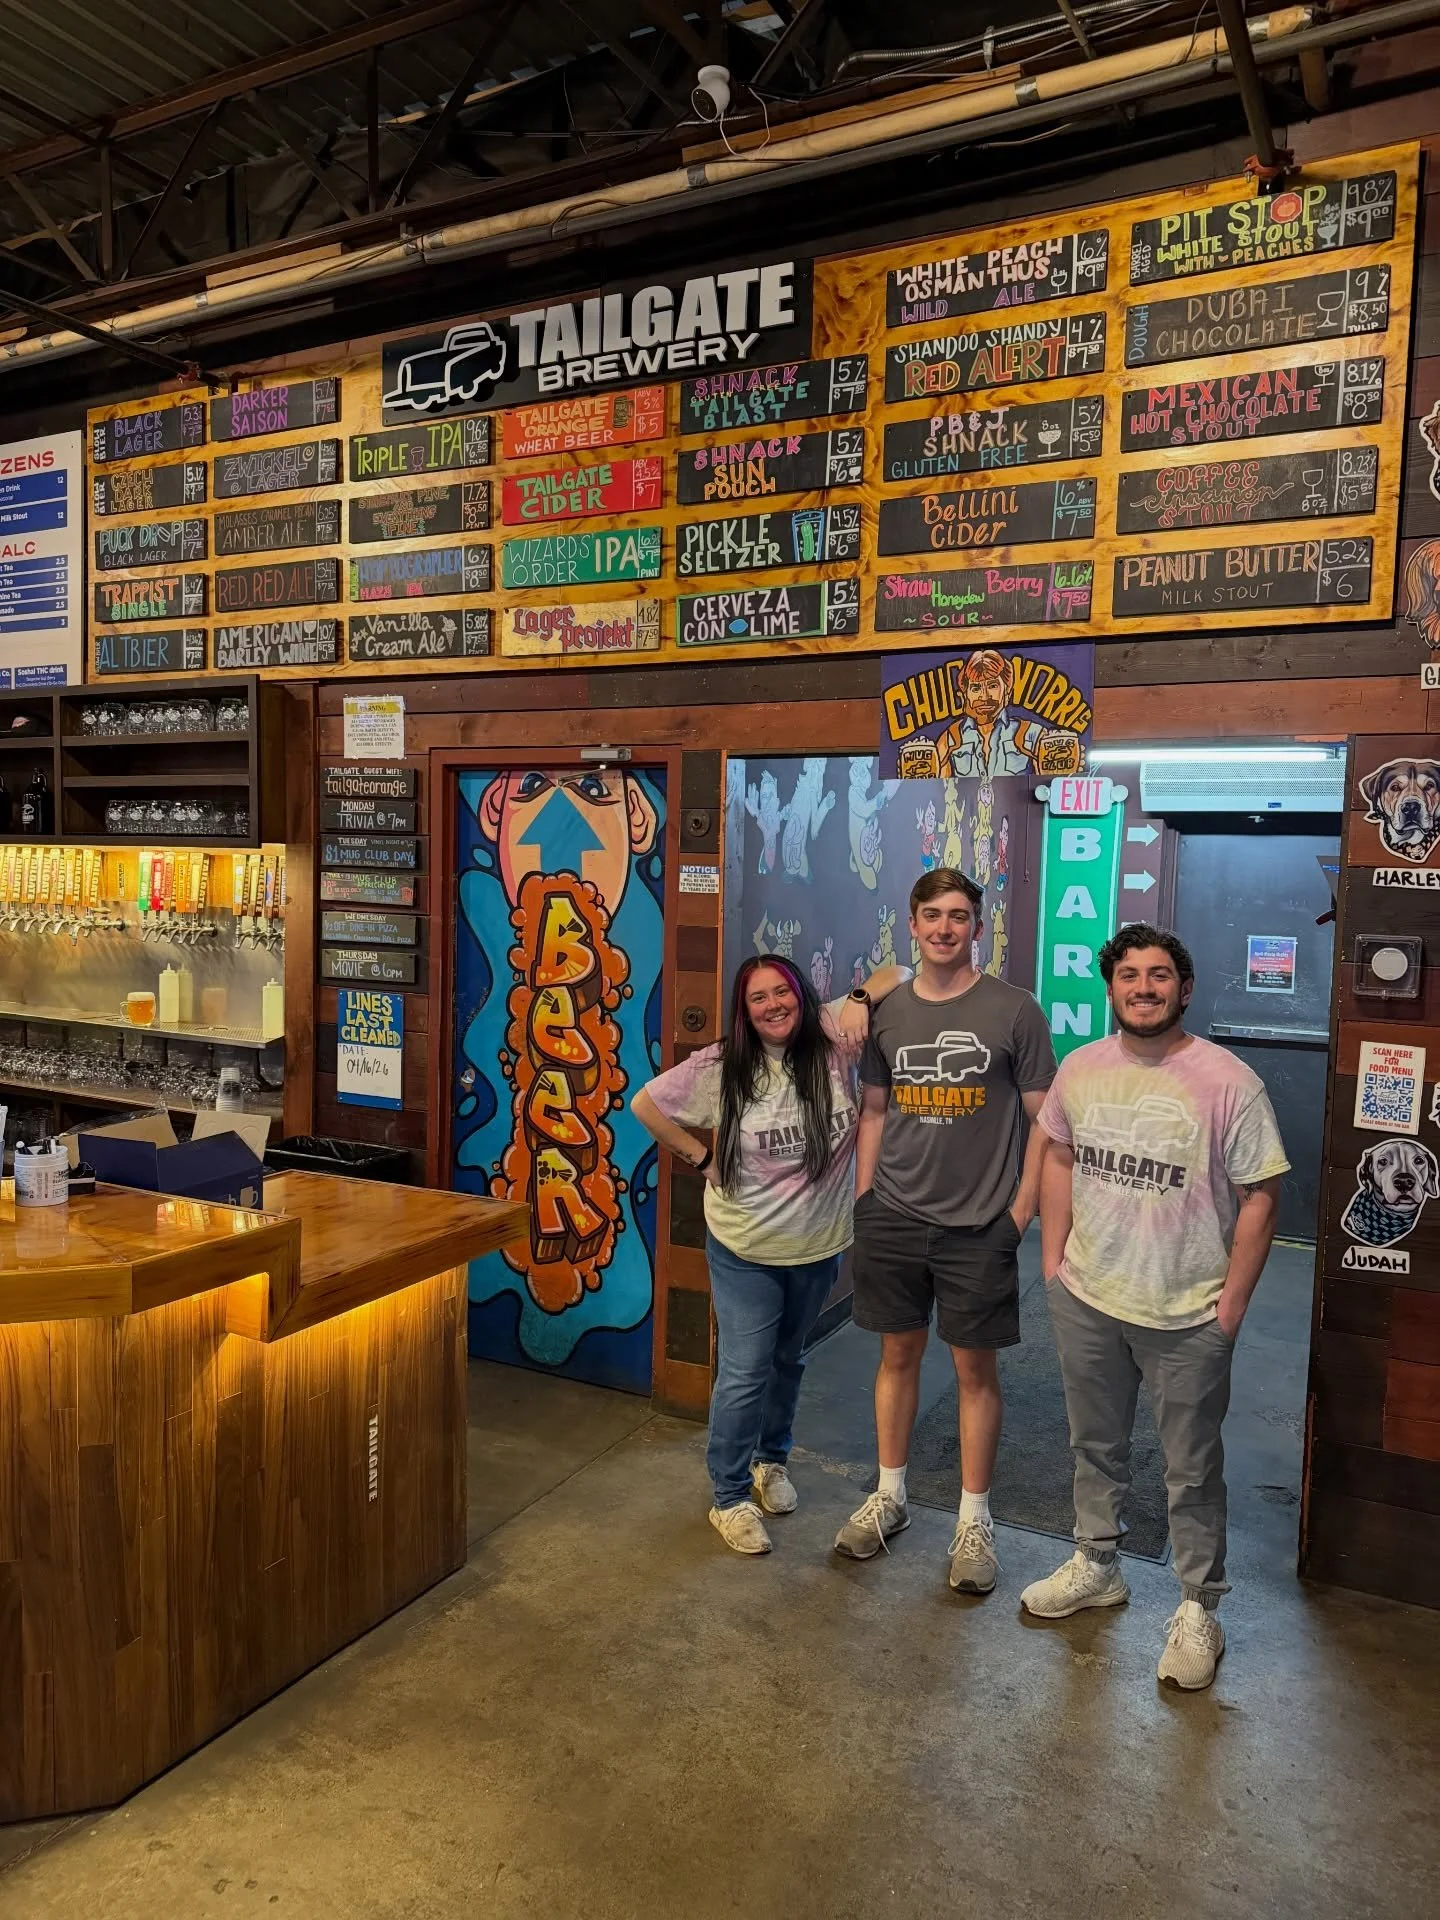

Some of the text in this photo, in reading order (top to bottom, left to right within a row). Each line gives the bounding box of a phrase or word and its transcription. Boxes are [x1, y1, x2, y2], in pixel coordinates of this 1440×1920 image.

[1160, 208, 1213, 245] PIT
[1079, 236, 1107, 261] 6%
[1157, 220, 1319, 263] WHITE STOUT
[1174, 236, 1314, 274] WITH PEACHES
[896, 238, 1063, 286] WHITE PEACH
[1130, 239, 1143, 279] BARREL
[1140, 244, 1151, 273] AGED
[510, 262, 795, 368] TAILGATE
[901, 283, 1036, 324] WILD ALE
[1187, 284, 1295, 323] DUBAI
[1071, 318, 1104, 342] 4%
[1128, 304, 1149, 361] DOUGH
[1155, 312, 1317, 357] CHOCOLATE
[1347, 320, 1380, 333] TULIP
[894, 318, 1062, 364] SHANDOO SHANDY
[538, 333, 760, 392] BREWERY
[838, 360, 866, 382] 5%
[904, 336, 1066, 398] RED ALERT
[1347, 360, 1383, 386] 8.1%
[695, 365, 799, 398] SHNACK
[1147, 367, 1298, 412] MEXICAN
[232, 387, 289, 416] DARKER
[516, 396, 610, 427] TAILGATE
[643, 398, 660, 410] 5%
[690, 381, 811, 418] TAILGATE
[1130, 387, 1322, 435] HOT CHOCOLATE
[114, 411, 163, 438] BLACK
[231, 408, 288, 437] SAISON
[524, 416, 606, 438] ORANGE
[704, 403, 786, 430] BLAST
[114, 430, 164, 457] LAGER
[514, 429, 614, 454] WHEAT BEER
[836, 432, 863, 454] 5%
[923, 420, 1028, 457] SHNACK
[1170, 418, 1262, 445] STOUT
[353, 437, 409, 476] TRIPLE
[426, 422, 464, 468] IPA
[694, 436, 803, 471] SHNACK
[891, 444, 1029, 479] GLUTEN FREE
[223, 447, 308, 481] ZWICKEL
[635, 459, 647, 469] ABV
[714, 459, 765, 486] SUN
[1156, 461, 1260, 493] COFFEE
[6, 484, 21, 492] Drink
[110, 469, 154, 492] CZECH
[114, 482, 153, 503] DARK
[246, 468, 300, 493] LAGER
[516, 464, 613, 498] TAILGATE
[704, 477, 776, 501] POUCH
[12, 512, 28, 521] Stout
[110, 497, 154, 513] LAGER
[520, 488, 607, 519] CIDER
[921, 487, 1019, 525] Bellini
[1157, 503, 1260, 529] STOUT
[219, 507, 292, 529] MOLASSES CARAMEL
[832, 508, 859, 528] 4.5%
[100, 527, 135, 554] PUCK
[222, 519, 308, 549] AMBER ALE
[685, 514, 772, 553] PICKLE
[104, 550, 167, 568] BLACK LAGER
[594, 536, 640, 573] IPA
[679, 543, 783, 574] SELTZER
[1122, 540, 1320, 592] PEANUT BUTTER
[1324, 540, 1370, 565] 5.2%
[253, 569, 285, 603] RED
[287, 567, 316, 600] ALE
[513, 561, 580, 585] ORDER
[640, 568, 660, 577] PINT
[884, 570, 1043, 600] Straw Berry
[101, 578, 179, 607] TRAPPIST
[693, 587, 791, 622] CERVEZA
[833, 581, 858, 605] 5%
[930, 580, 985, 610] Honeydew
[1161, 582, 1274, 606] MILK STOUT
[111, 600, 167, 621] SINGLE
[365, 613, 434, 635] Vanilla
[218, 621, 303, 649] AMERICAN
[318, 624, 336, 641] 10%
[684, 611, 800, 643] CON LIME
[217, 642, 319, 668] BARLEY WINE
[365, 629, 447, 657] Cream Ale
[49, 665, 65, 673] drink
[1010, 655, 1092, 734] NORRIS
[904, 749, 933, 763] MUG
[1044, 738, 1075, 751] MUG
[328, 767, 383, 775] TAILGATE GUEST
[1041, 759, 1076, 772] CLUB
[325, 776, 407, 798] tailgateorange
[1060, 779, 1103, 811] EXIT
[340, 801, 375, 812] MONDAY
[336, 812, 386, 829] TRIVIA @
[337, 837, 368, 846] TUESDAY
[340, 849, 412, 862] MUG CLUB DAY
[682, 865, 718, 873] NOTICE
[345, 912, 387, 922] WEDNESDAY
[1050, 827, 1102, 1037] BARN
[331, 960, 381, 977] MOVIE @
[336, 950, 378, 960] THURSDAY
[347, 991, 393, 1016] LINES
[345, 1009, 394, 1031] LAST
[341, 1025, 402, 1047] CLEANED
[1373, 1047, 1414, 1059] SCAN HERE
[1384, 1056, 1400, 1066] FOR
[1369, 1063, 1414, 1076] FOOD MENU
[893, 1085, 986, 1107] TAILGATE
[900, 1104, 977, 1117] BREWERY
[1081, 1166, 1170, 1196] BREWERY
[1343, 1247, 1408, 1272] JUDAH
[368, 1413, 379, 1503] TAILGATE
